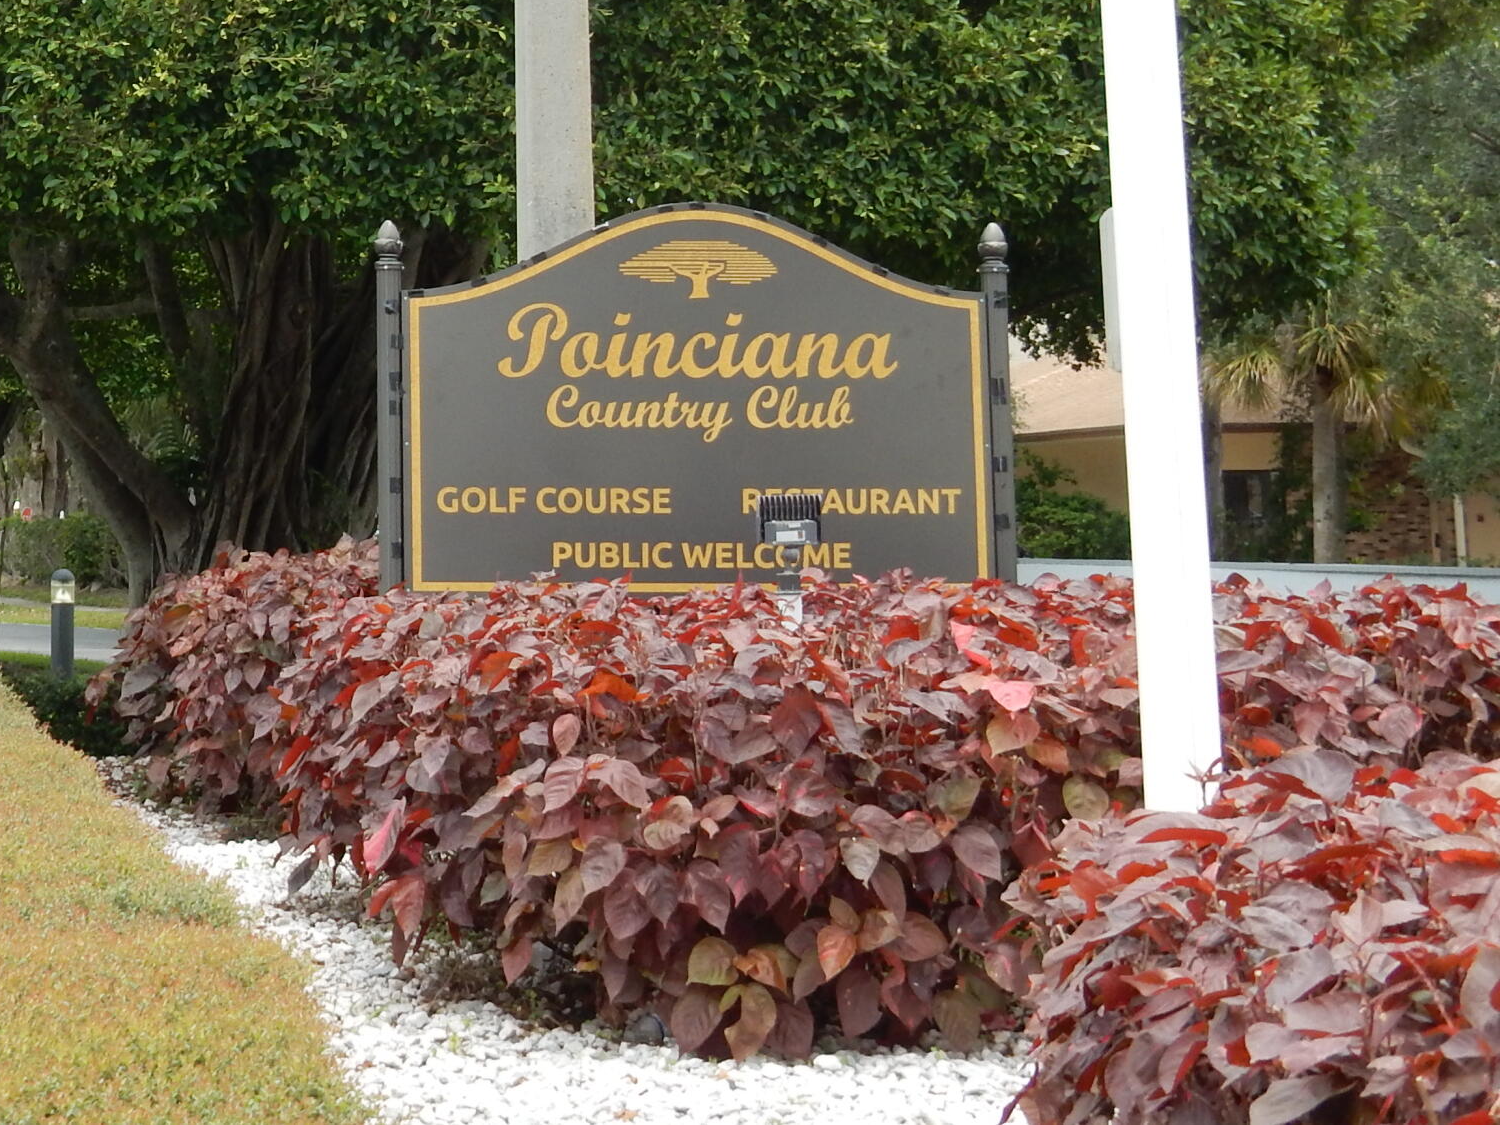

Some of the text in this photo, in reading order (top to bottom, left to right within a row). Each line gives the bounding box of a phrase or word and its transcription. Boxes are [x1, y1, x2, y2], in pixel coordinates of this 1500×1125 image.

[497, 302, 898, 379] Poinciana
[545, 384, 854, 443] Country Club
[436, 486, 672, 515] GOLF COURSE
[741, 487, 962, 515] RAURANT
[551, 541, 673, 569] PUBLIC
